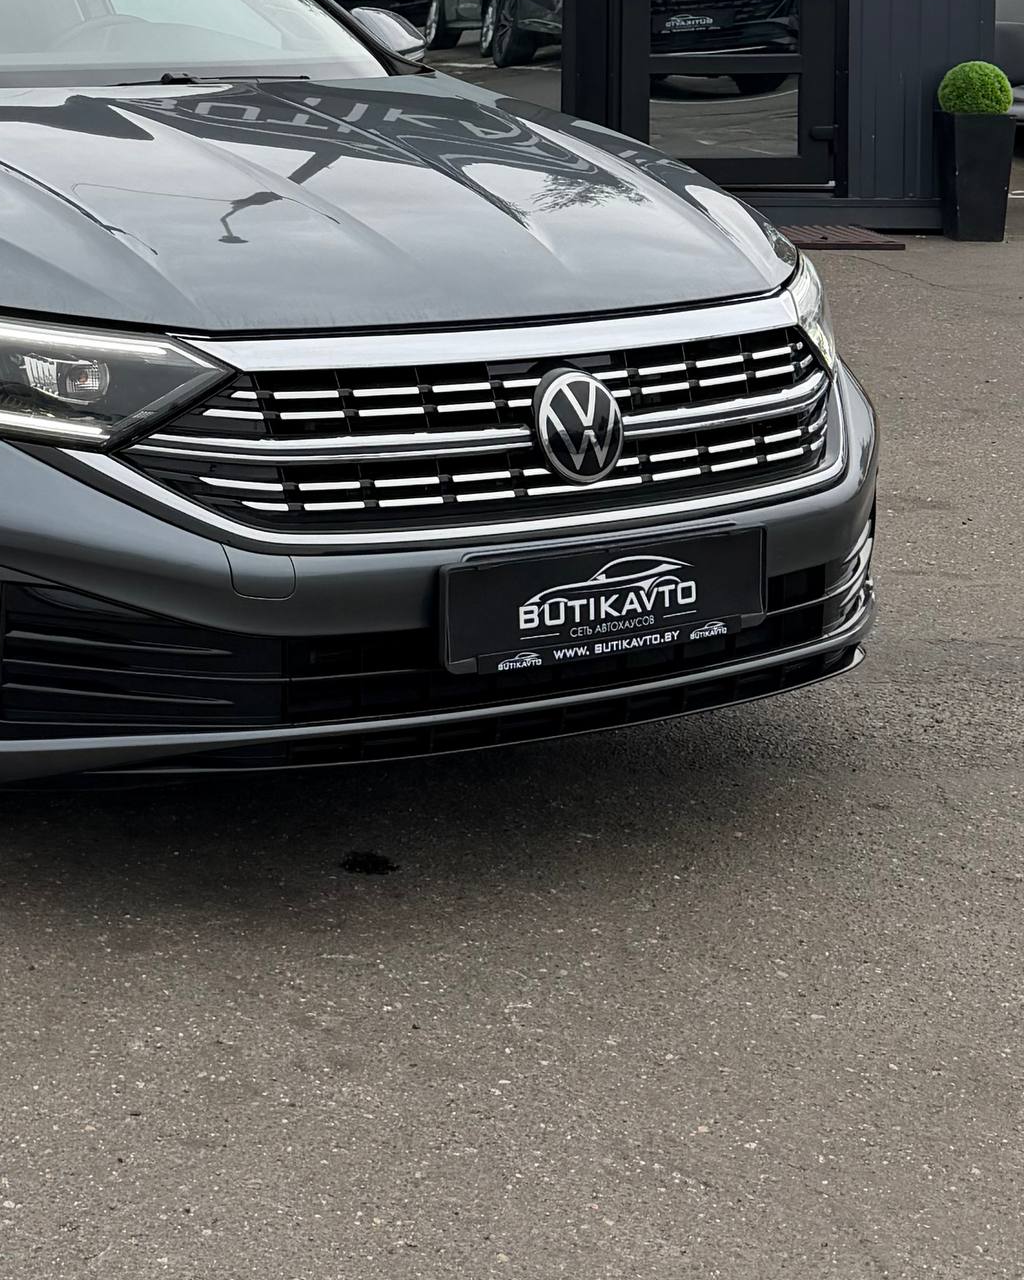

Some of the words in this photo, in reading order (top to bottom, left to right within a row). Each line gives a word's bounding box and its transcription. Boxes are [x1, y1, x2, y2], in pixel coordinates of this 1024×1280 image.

[519, 580, 697, 629] BUTIKAVTO
[569, 626, 593, 638] СЕТЬ
[594, 615, 655, 633] АВТОХАУСОВ
[690, 626, 727, 640] BUTIKAVTO
[553, 646, 590, 660] WWW.
[594, 630, 680, 654] BUTIKAVTO.BY
[497, 658, 543, 671] BUTIKAVTO
